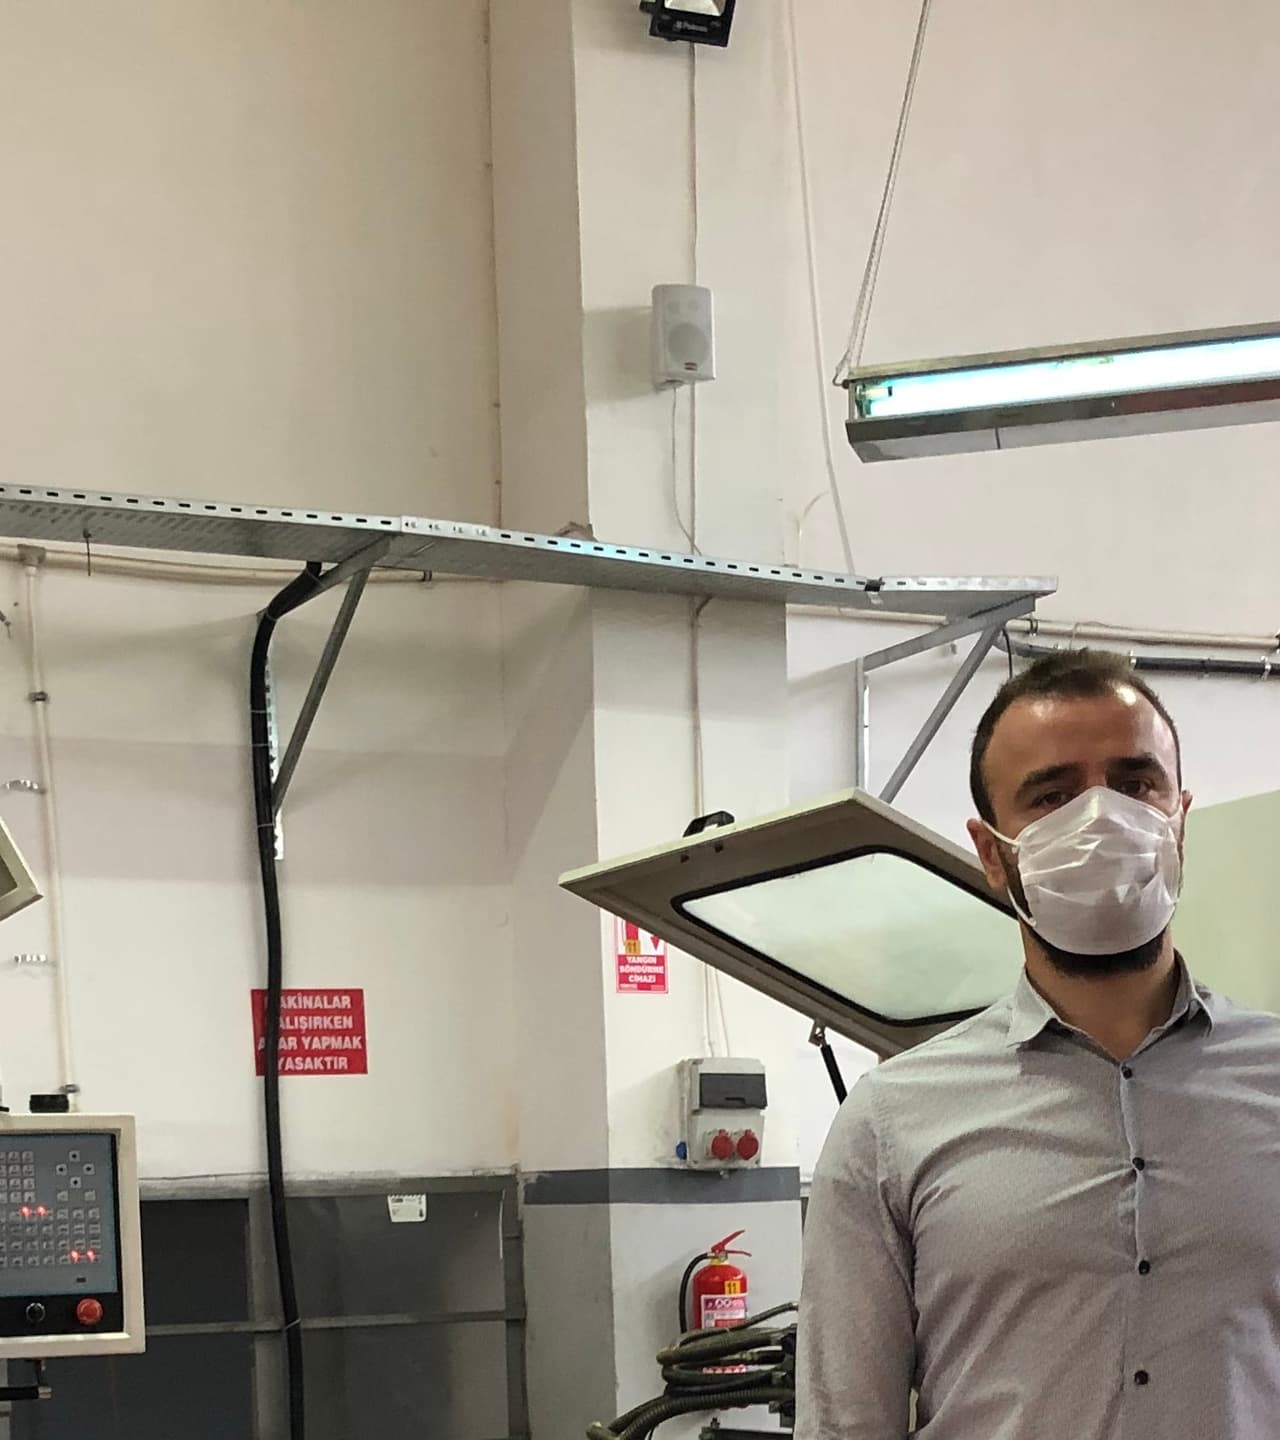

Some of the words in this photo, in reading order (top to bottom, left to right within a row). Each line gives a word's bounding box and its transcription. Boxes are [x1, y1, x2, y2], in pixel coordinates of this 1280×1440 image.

[265, 992, 352, 1009] AKİNALAR
[279, 1015, 353, 1034] ALIŞIRKEN
[257, 1036, 298, 1051] AAR
[302, 1035, 363, 1050] YAPMAK
